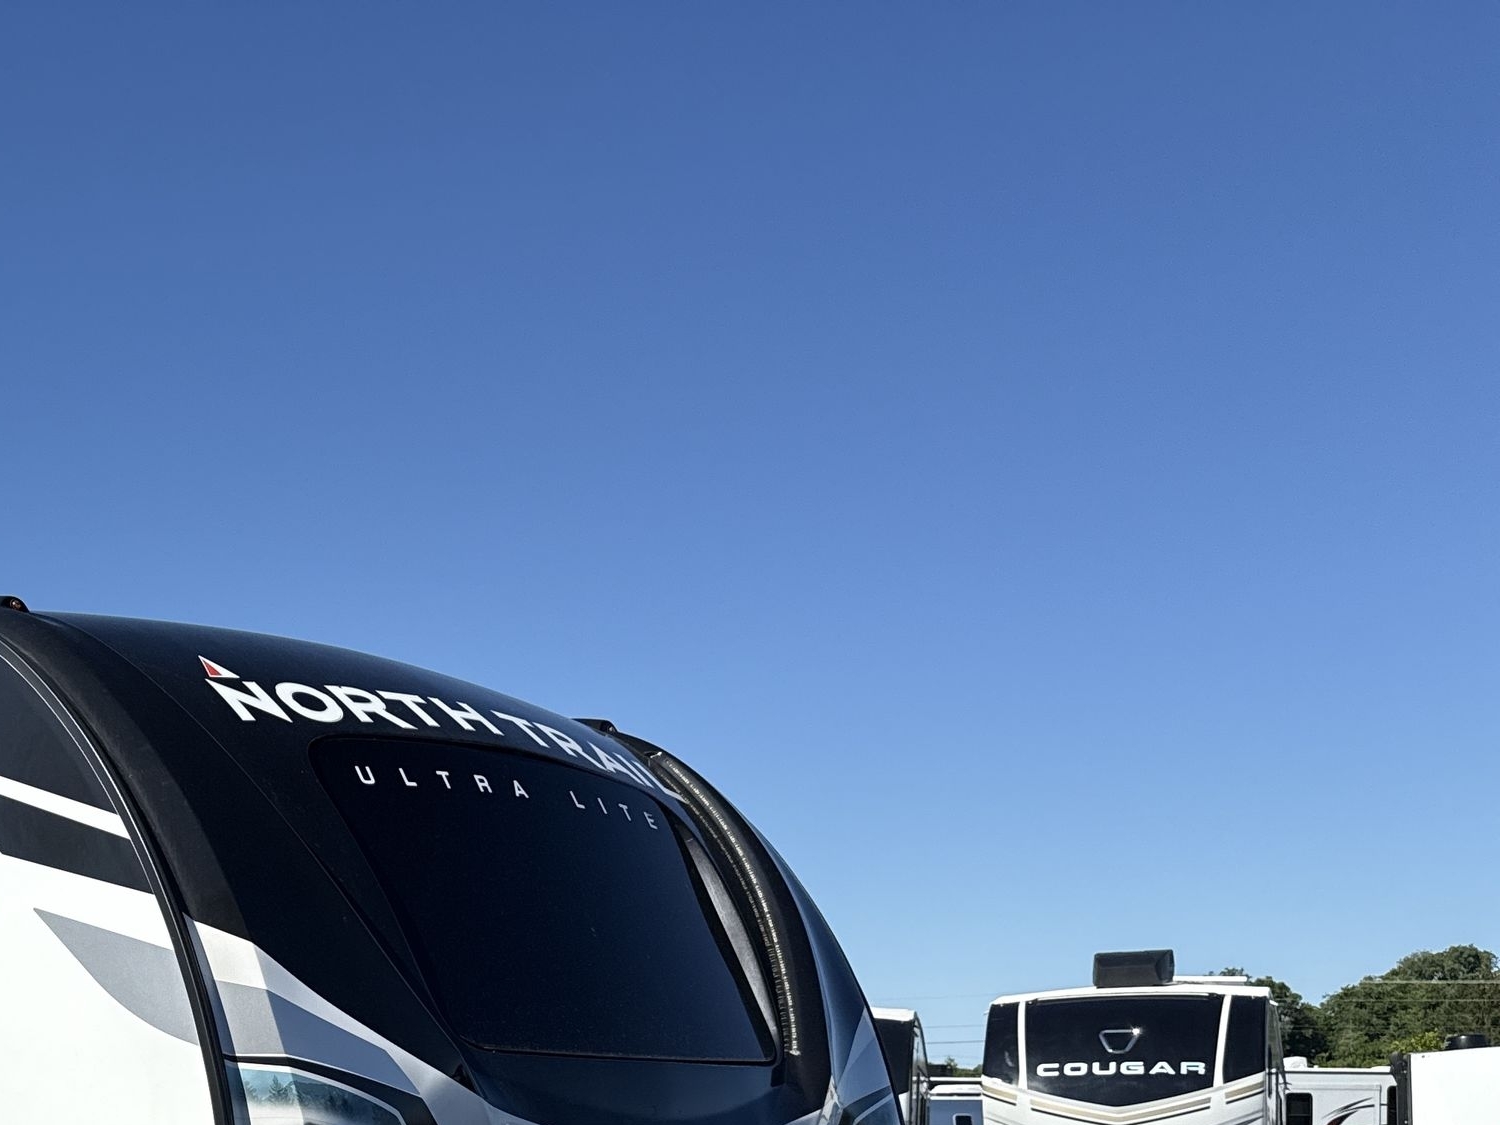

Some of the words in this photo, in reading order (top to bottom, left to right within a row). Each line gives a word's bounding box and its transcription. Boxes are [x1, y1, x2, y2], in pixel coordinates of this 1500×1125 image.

[205, 678, 505, 736] NORTH
[490, 709, 689, 805] TRAIL
[355, 765, 530, 799] ULTRA
[569, 790, 658, 830] LITE
[1036, 1061, 1206, 1077] COUGAR
